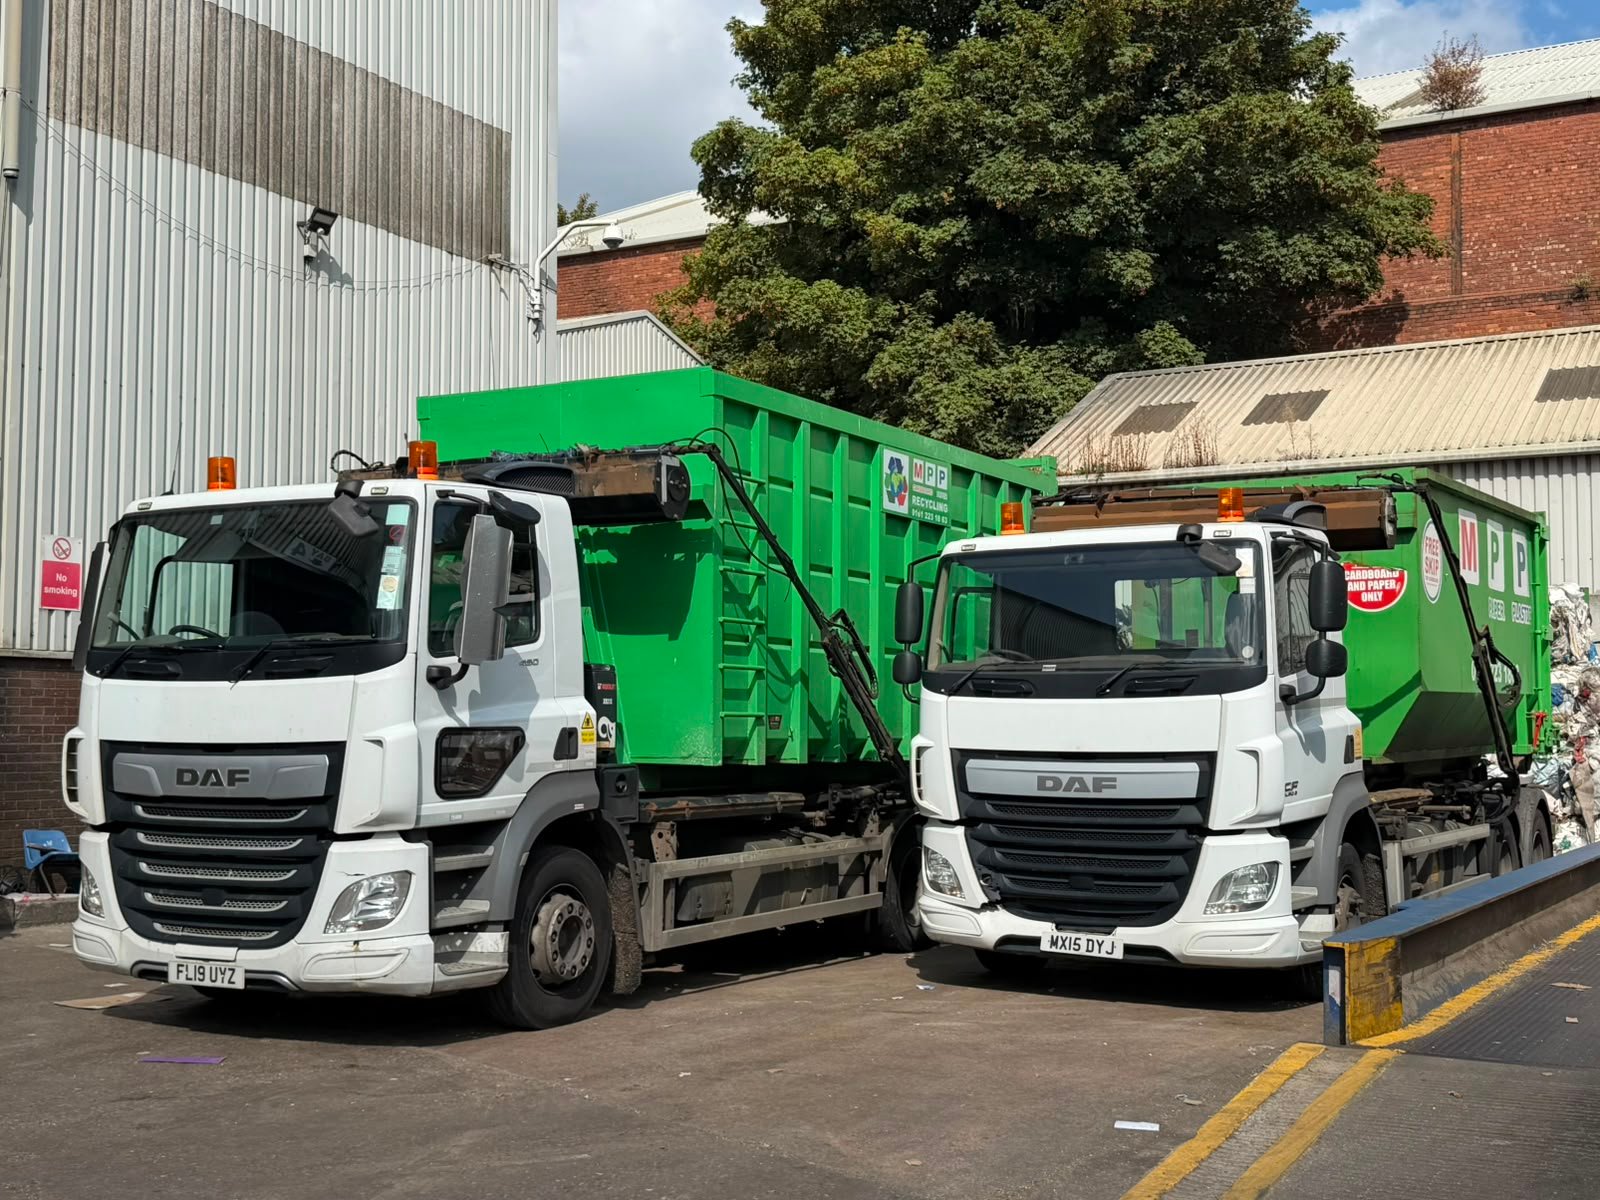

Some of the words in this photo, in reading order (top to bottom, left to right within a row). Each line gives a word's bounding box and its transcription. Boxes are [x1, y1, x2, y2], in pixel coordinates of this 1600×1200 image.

[914, 462, 946, 485] MPP
[912, 495, 948, 513] RECYCLING
[1425, 536, 1439, 557] FREE
[1461, 519, 1527, 588] MPP
[1345, 569, 1399, 581] CARDBOARD
[1425, 556, 1438, 577] SKIP
[55, 573, 67, 582] No
[1347, 580, 1366, 592] AND
[1367, 579, 1396, 591] PAPER
[44, 586, 78, 597] smoking
[1361, 591, 1383, 603] ONLY
[176, 768, 250, 787] DAF
[1037, 775, 1117, 793] DAF
[1050, 934, 1081, 952] MX15
[1085, 938, 1115, 955] DYJ
[177, 963, 205, 982] FL19
[209, 966, 236, 984] UYZ
